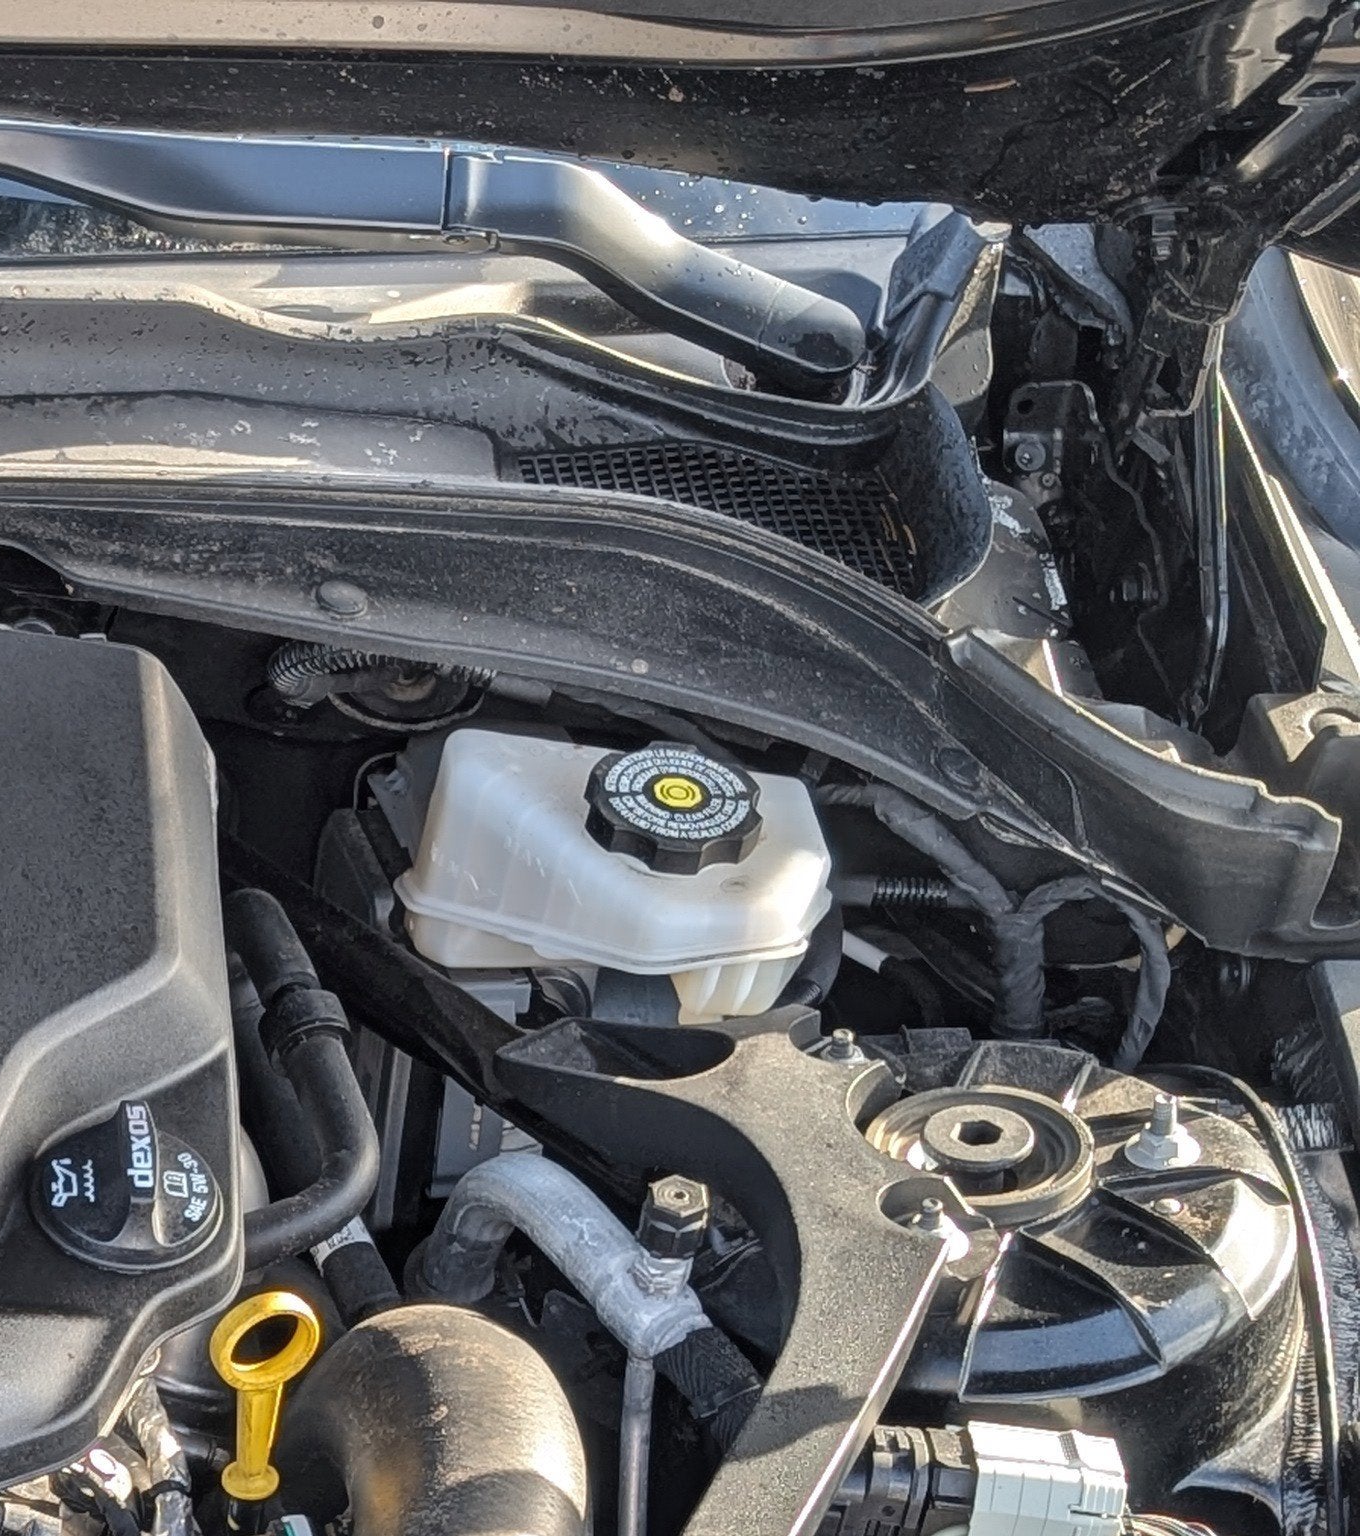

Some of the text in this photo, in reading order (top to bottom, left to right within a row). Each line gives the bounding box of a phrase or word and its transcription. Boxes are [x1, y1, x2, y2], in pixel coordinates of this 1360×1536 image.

[126, 1106, 153, 1188] dexos
[177, 1152, 209, 1223] SAE 5W-30
